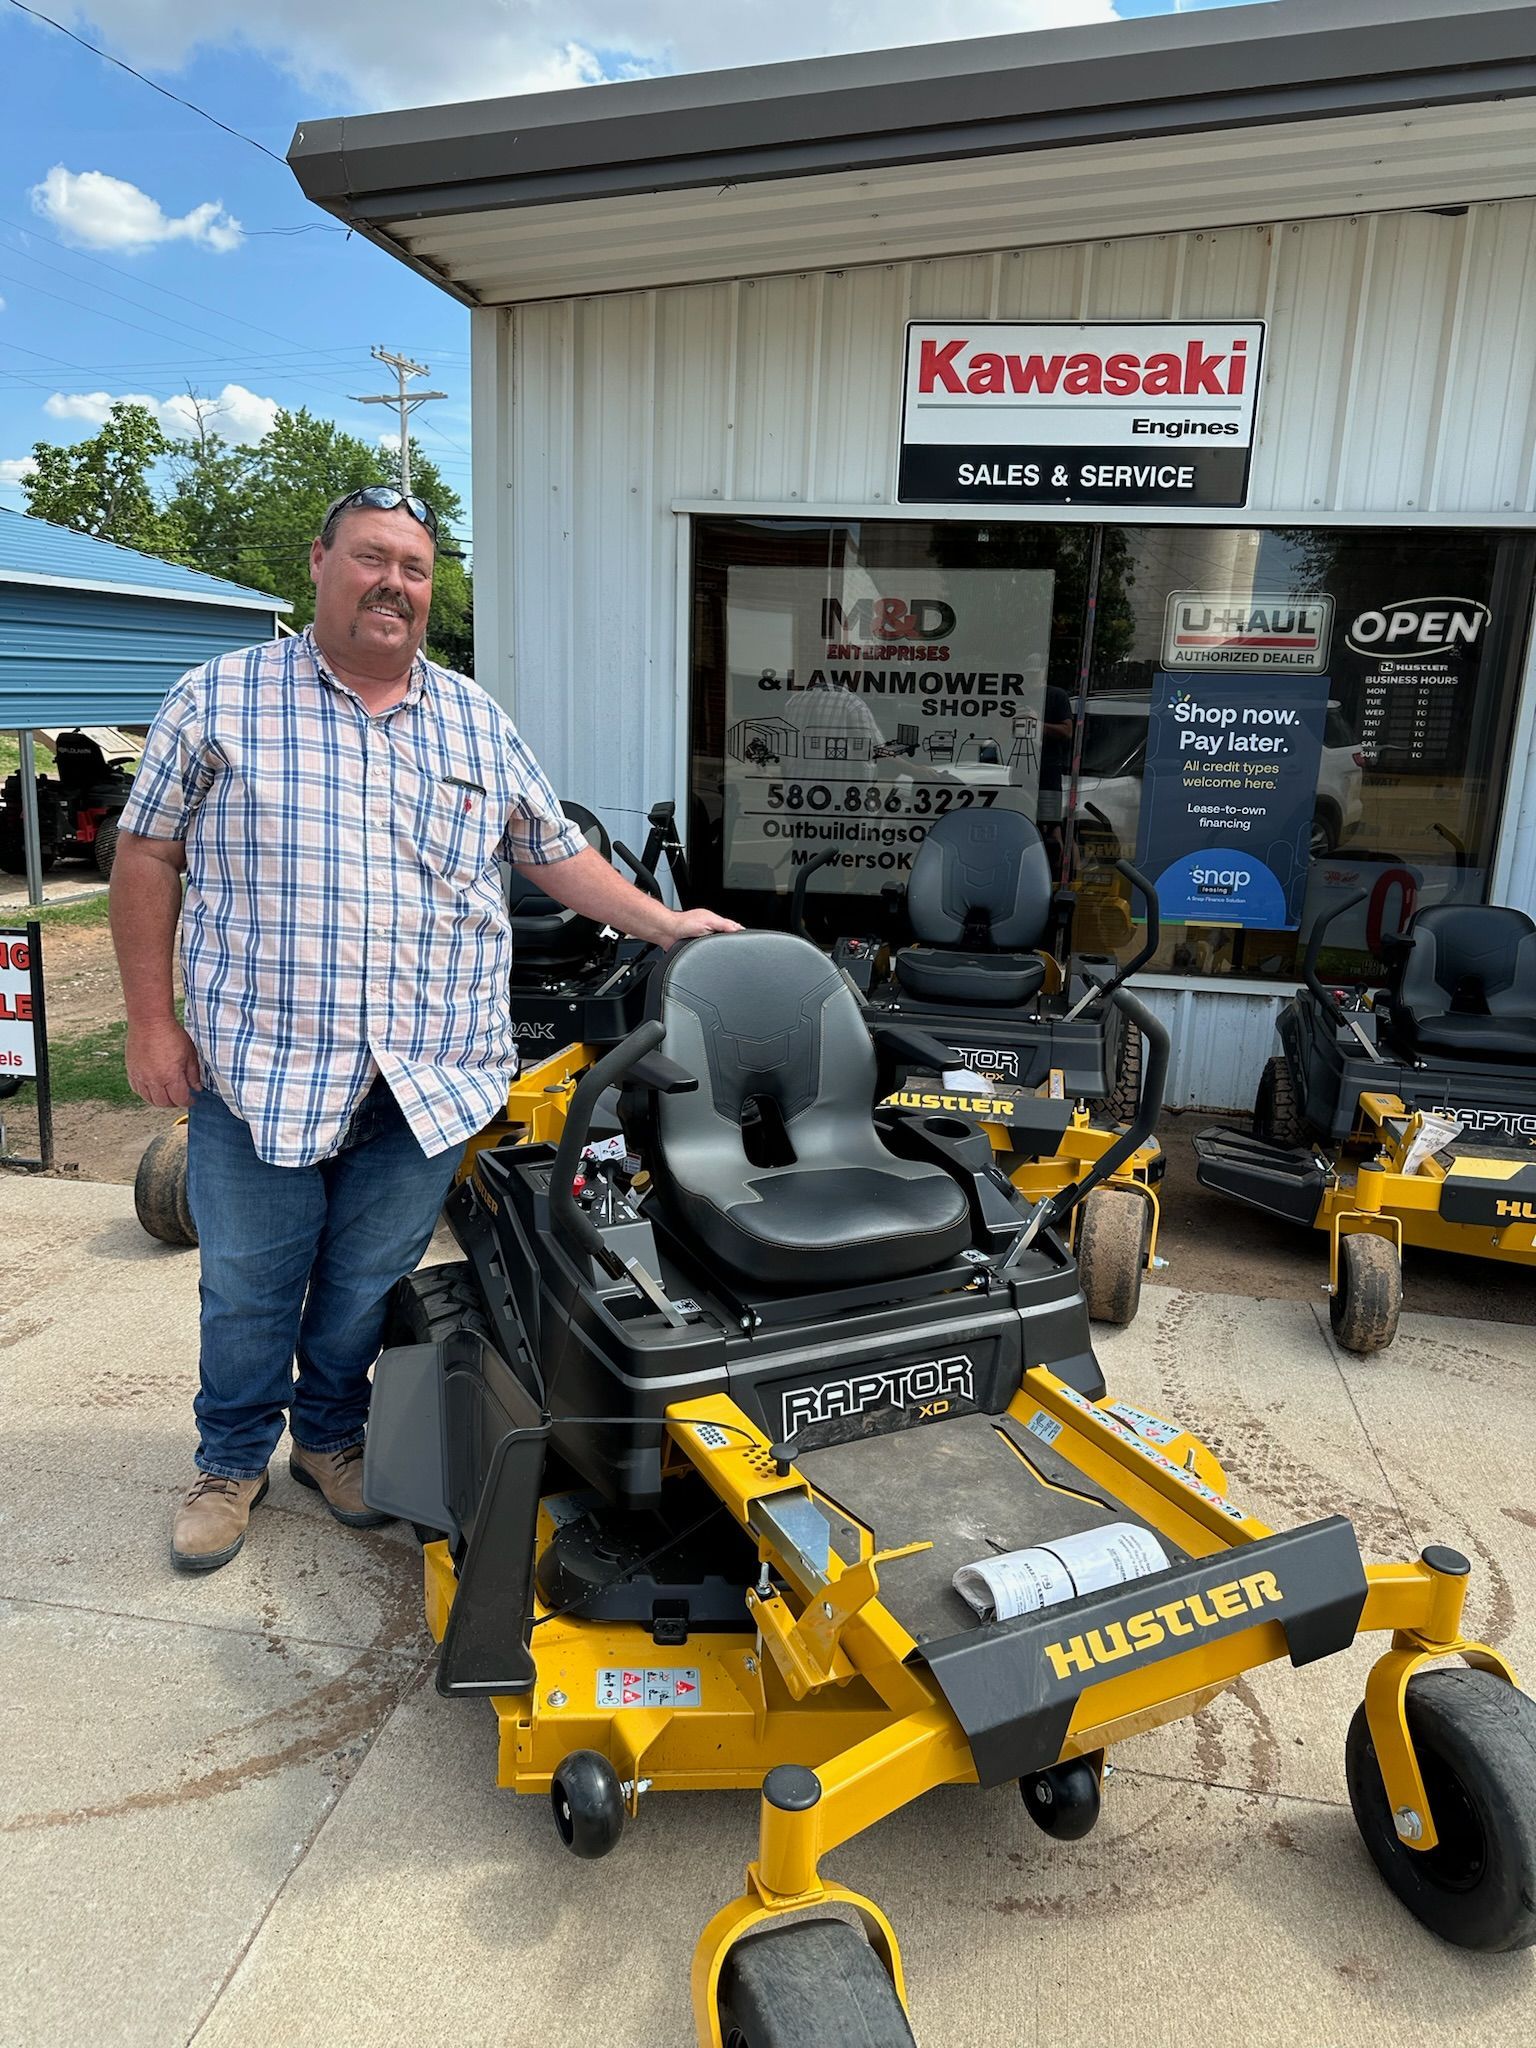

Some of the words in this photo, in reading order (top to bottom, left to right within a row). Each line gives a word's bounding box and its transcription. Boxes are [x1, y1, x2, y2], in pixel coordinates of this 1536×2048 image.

[918, 340, 1247, 395] Kawasaki
[1131, 418, 1239, 438] Engines
[957, 463, 1040, 487] SALES
[1050, 465, 1069, 488] &
[1079, 465, 1195, 488] SERVICE
[821, 597, 956, 641] M&D
[1182, 607, 1316, 634] U-HAUL
[1351, 610, 1484, 643] OPEN
[826, 644, 951, 662] ENTERPRISES
[1174, 651, 1259, 663] AUTHORIZED
[1262, 653, 1315, 665] DEALER
[1395, 664, 1449, 672] HUSTLER
[1364, 675, 1418, 685] BUSINESS
[1420, 676, 1459, 685] HOURS
[921, 698, 1017, 718] SHOPS
[1365, 698, 1382, 706] TUE
[1174, 702, 1238, 728] Shop
[1242, 707, 1301, 726] now.
[1363, 719, 1381, 727] THU
[1415, 709, 1427, 717] TO
[1179, 730, 1224, 756] Pay
[1227, 731, 1289, 753] later.
[1183, 760, 1199, 772] All
[1202, 761, 1240, 773] credit
[1243, 762, 1280, 776] types
[1183, 776, 1242, 789] welcome
[767, 784, 999, 815] 580.886.3227
[1187, 803, 1267, 816] Lease-to-own
[762, 819, 937, 847] OutbuildingsO
[1199, 817, 1251, 832] financing
[1192, 869, 1251, 892] snap
[1202, 887, 1228, 895] leasing
[948, 1046, 1019, 1078] TOR
[782, 1354, 974, 1443] RAPTOR
[919, 1400, 949, 1419] XD
[1043, 1570, 1284, 1680] HUSTLER
